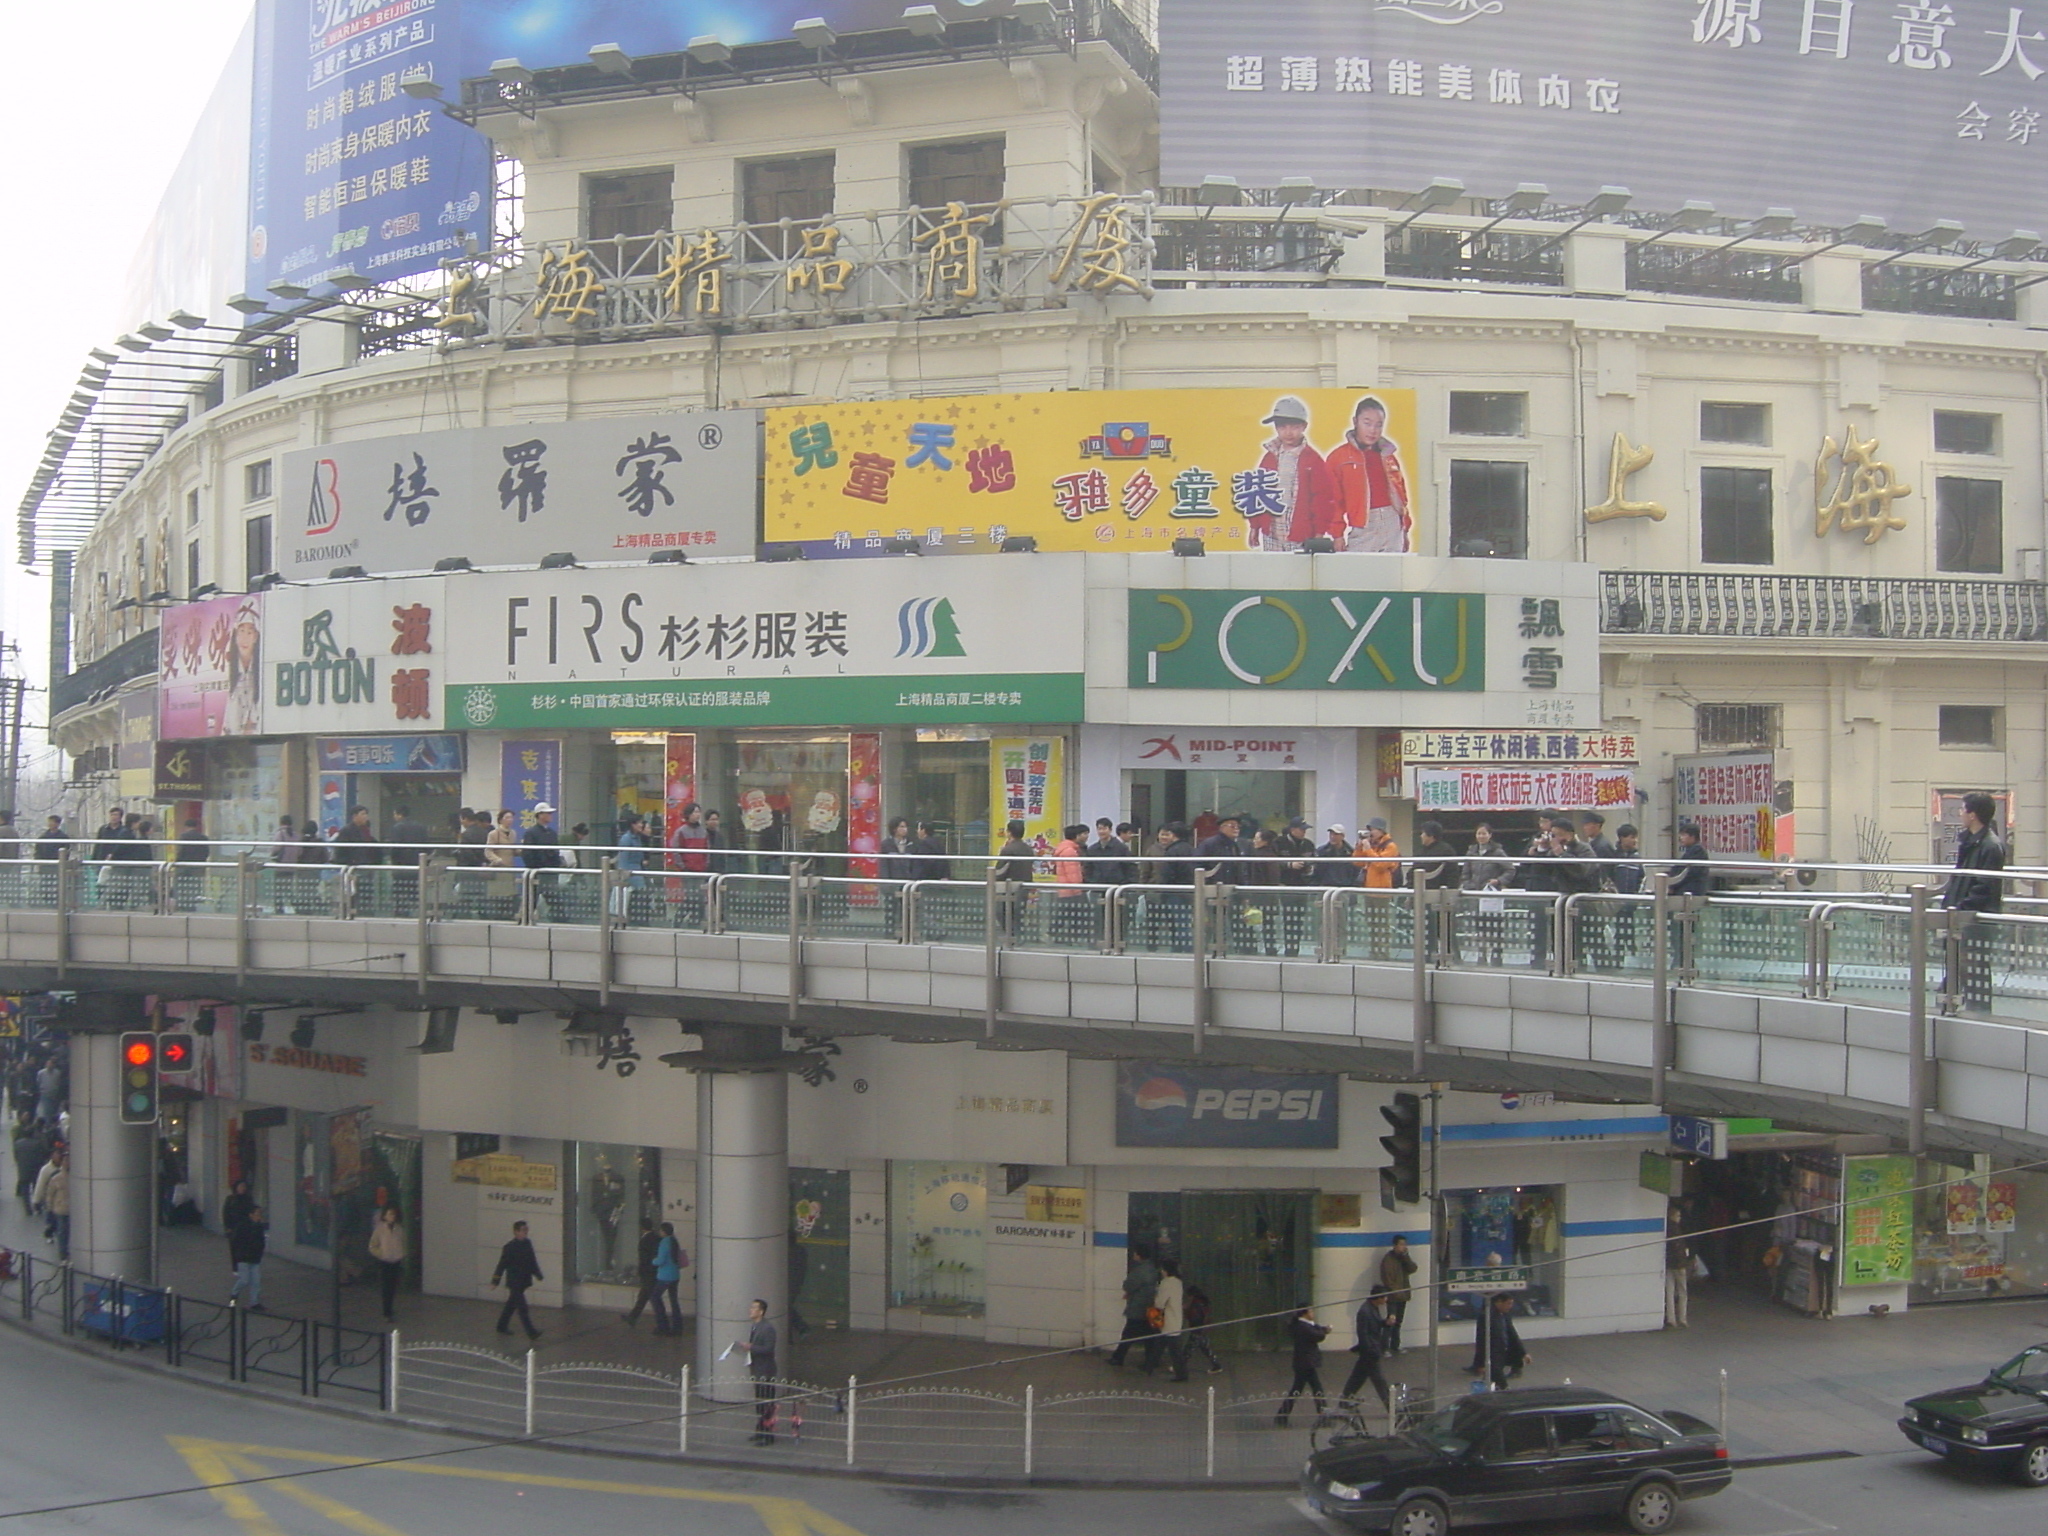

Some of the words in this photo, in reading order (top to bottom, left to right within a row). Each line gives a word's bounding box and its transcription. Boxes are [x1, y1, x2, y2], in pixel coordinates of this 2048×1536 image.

[310, 38, 327, 54] THE
[328, 17, 371, 43] WARM'S
[1225, 55, 1621, 115] 超薄热能美体内衣
[1954, 100, 2041, 145] 会穿
[303, 155, 430, 221] 智能恒温保暖鞋
[1053, 466, 1289, 520] 雅多童装
[1584, 423, 1912, 545] 上海
[612, 530, 718, 549] 上海精品商厦专卖
[833, 525, 1008, 550] 精品商厦三楼
[1124, 526, 1241, 540] 上海市名牌产品
[295, 542, 354, 564] BAROMON
[507, 591, 644, 666] FIRS
[656, 610, 851, 662] 杉杉服装
[1147, 593, 1469, 686] POXU
[391, 603, 432, 720] 波顿
[507, 663, 845, 681] NATURAL
[276, 657, 375, 707] BOTON
[895, 691, 1023, 708] 上海精品商厦二楼专卖
[1526, 700, 1575, 712] 上海精品
[345, 744, 395, 766] 百事可乐
[1188, 739, 1297, 752] MID-POINT
[1190, 753, 1296, 764] 交叉点
[1535, 772, 1558, 806] 大衣
[1192, 1088, 1323, 1120] PEPSI
